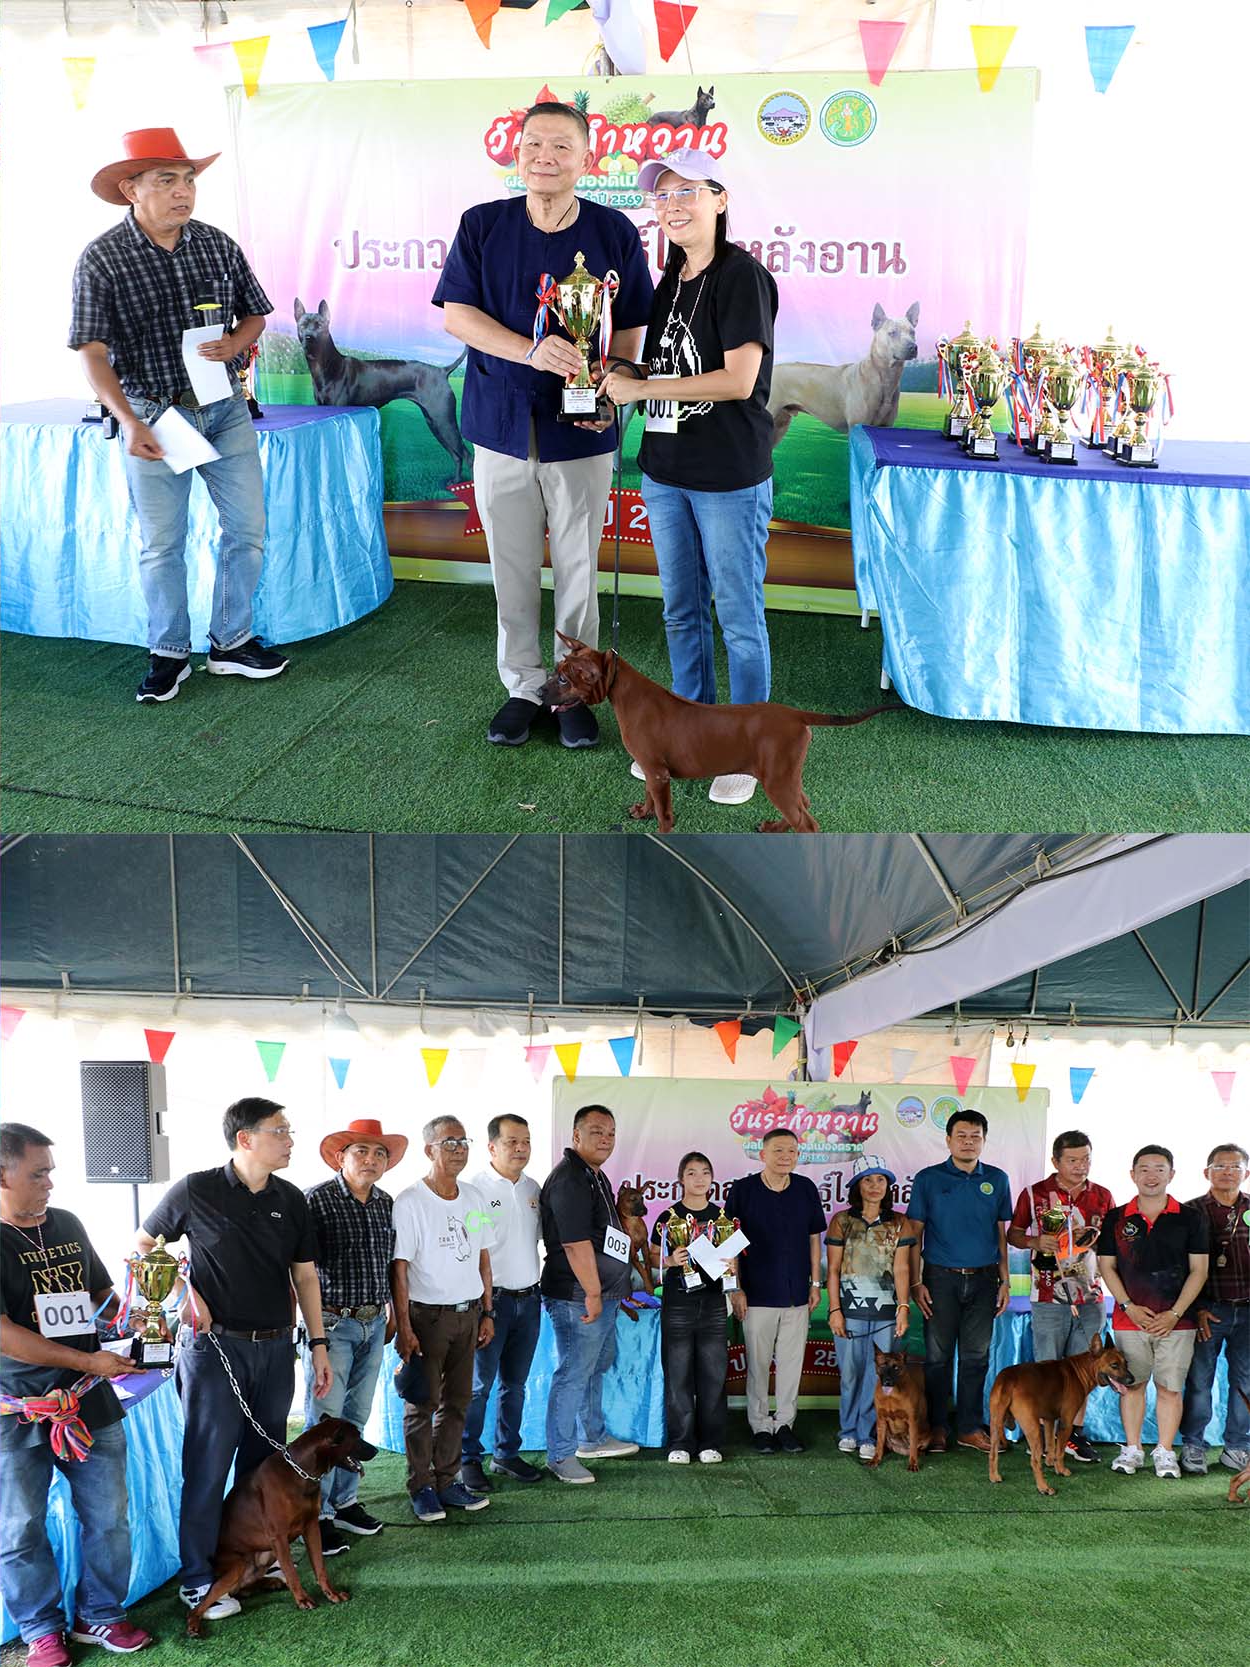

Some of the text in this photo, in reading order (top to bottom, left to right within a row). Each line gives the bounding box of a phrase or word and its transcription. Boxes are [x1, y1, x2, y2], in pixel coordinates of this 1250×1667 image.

[611, 194, 643, 206] 2569
[732, 1105, 878, 1132] วันระกำหวาน
[607, 1235, 627, 1255] 003
[44, 1304, 90, 1327] 001
